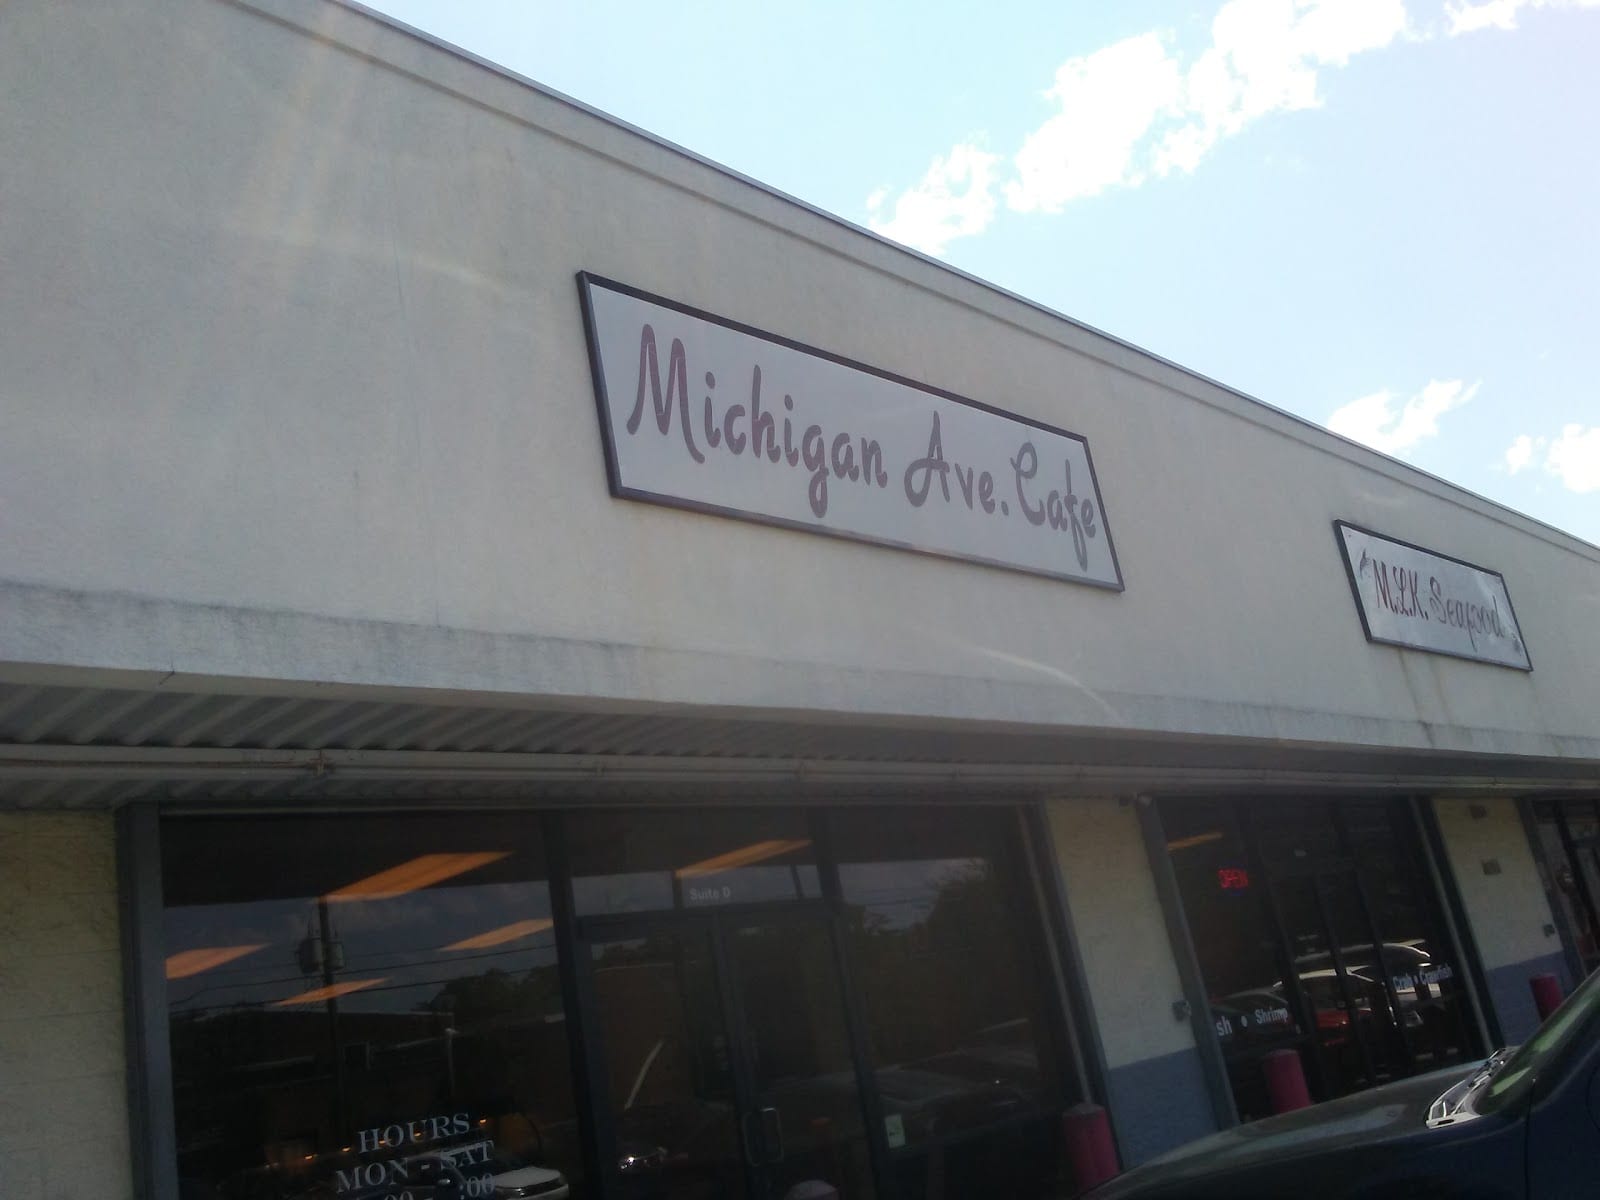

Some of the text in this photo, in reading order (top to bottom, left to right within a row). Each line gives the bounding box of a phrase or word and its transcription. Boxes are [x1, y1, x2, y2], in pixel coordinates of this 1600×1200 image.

[626, 323, 1096, 572] Michigan Ave. Cafe
[1215, 1005, 1289, 1037] sh Shrimp
[358, 1113, 470, 1153] HOURS
[336, 1157, 409, 1194] MON
[440, 1140, 495, 1171] SAT
